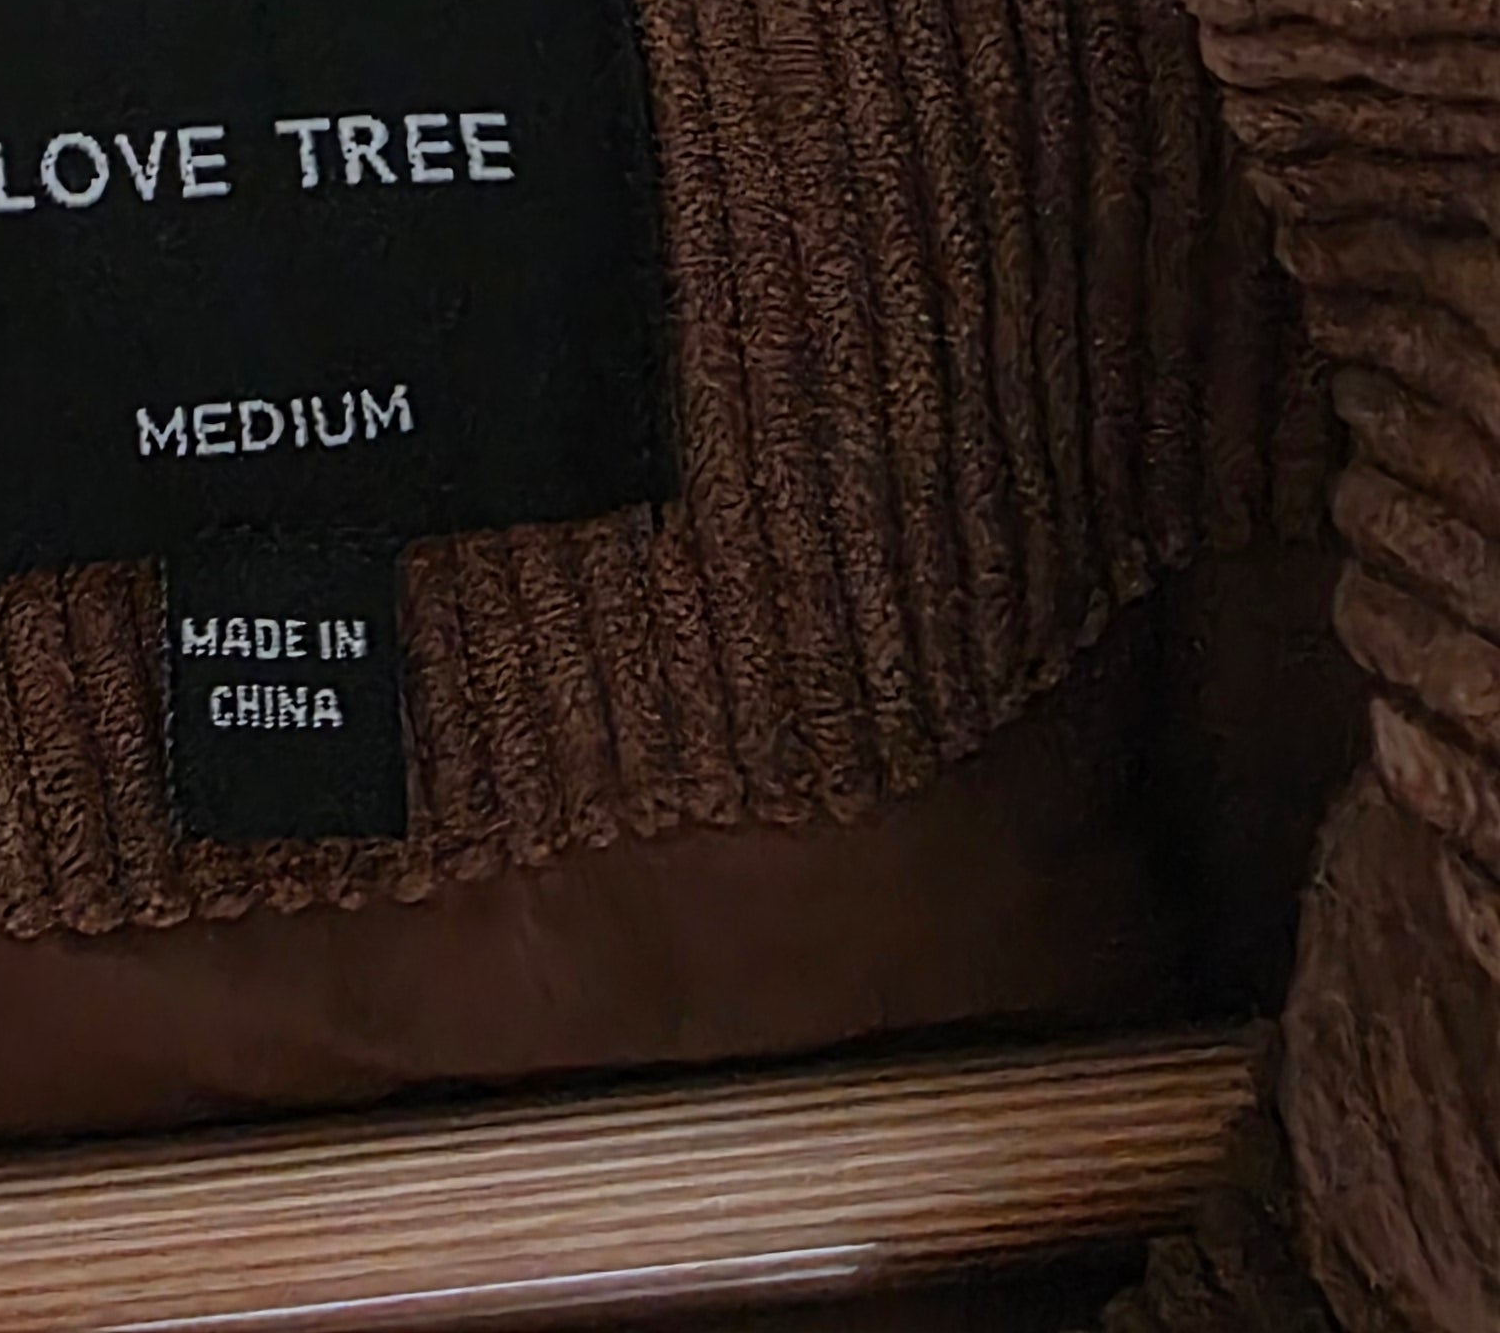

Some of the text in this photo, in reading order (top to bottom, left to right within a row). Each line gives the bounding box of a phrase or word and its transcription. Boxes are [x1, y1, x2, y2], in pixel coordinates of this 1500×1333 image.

[274, 112, 516, 189] TREE
[135, 384, 415, 457] MEDIUM
[181, 617, 367, 660] MADE IN
[210, 684, 343, 729] CHINA
